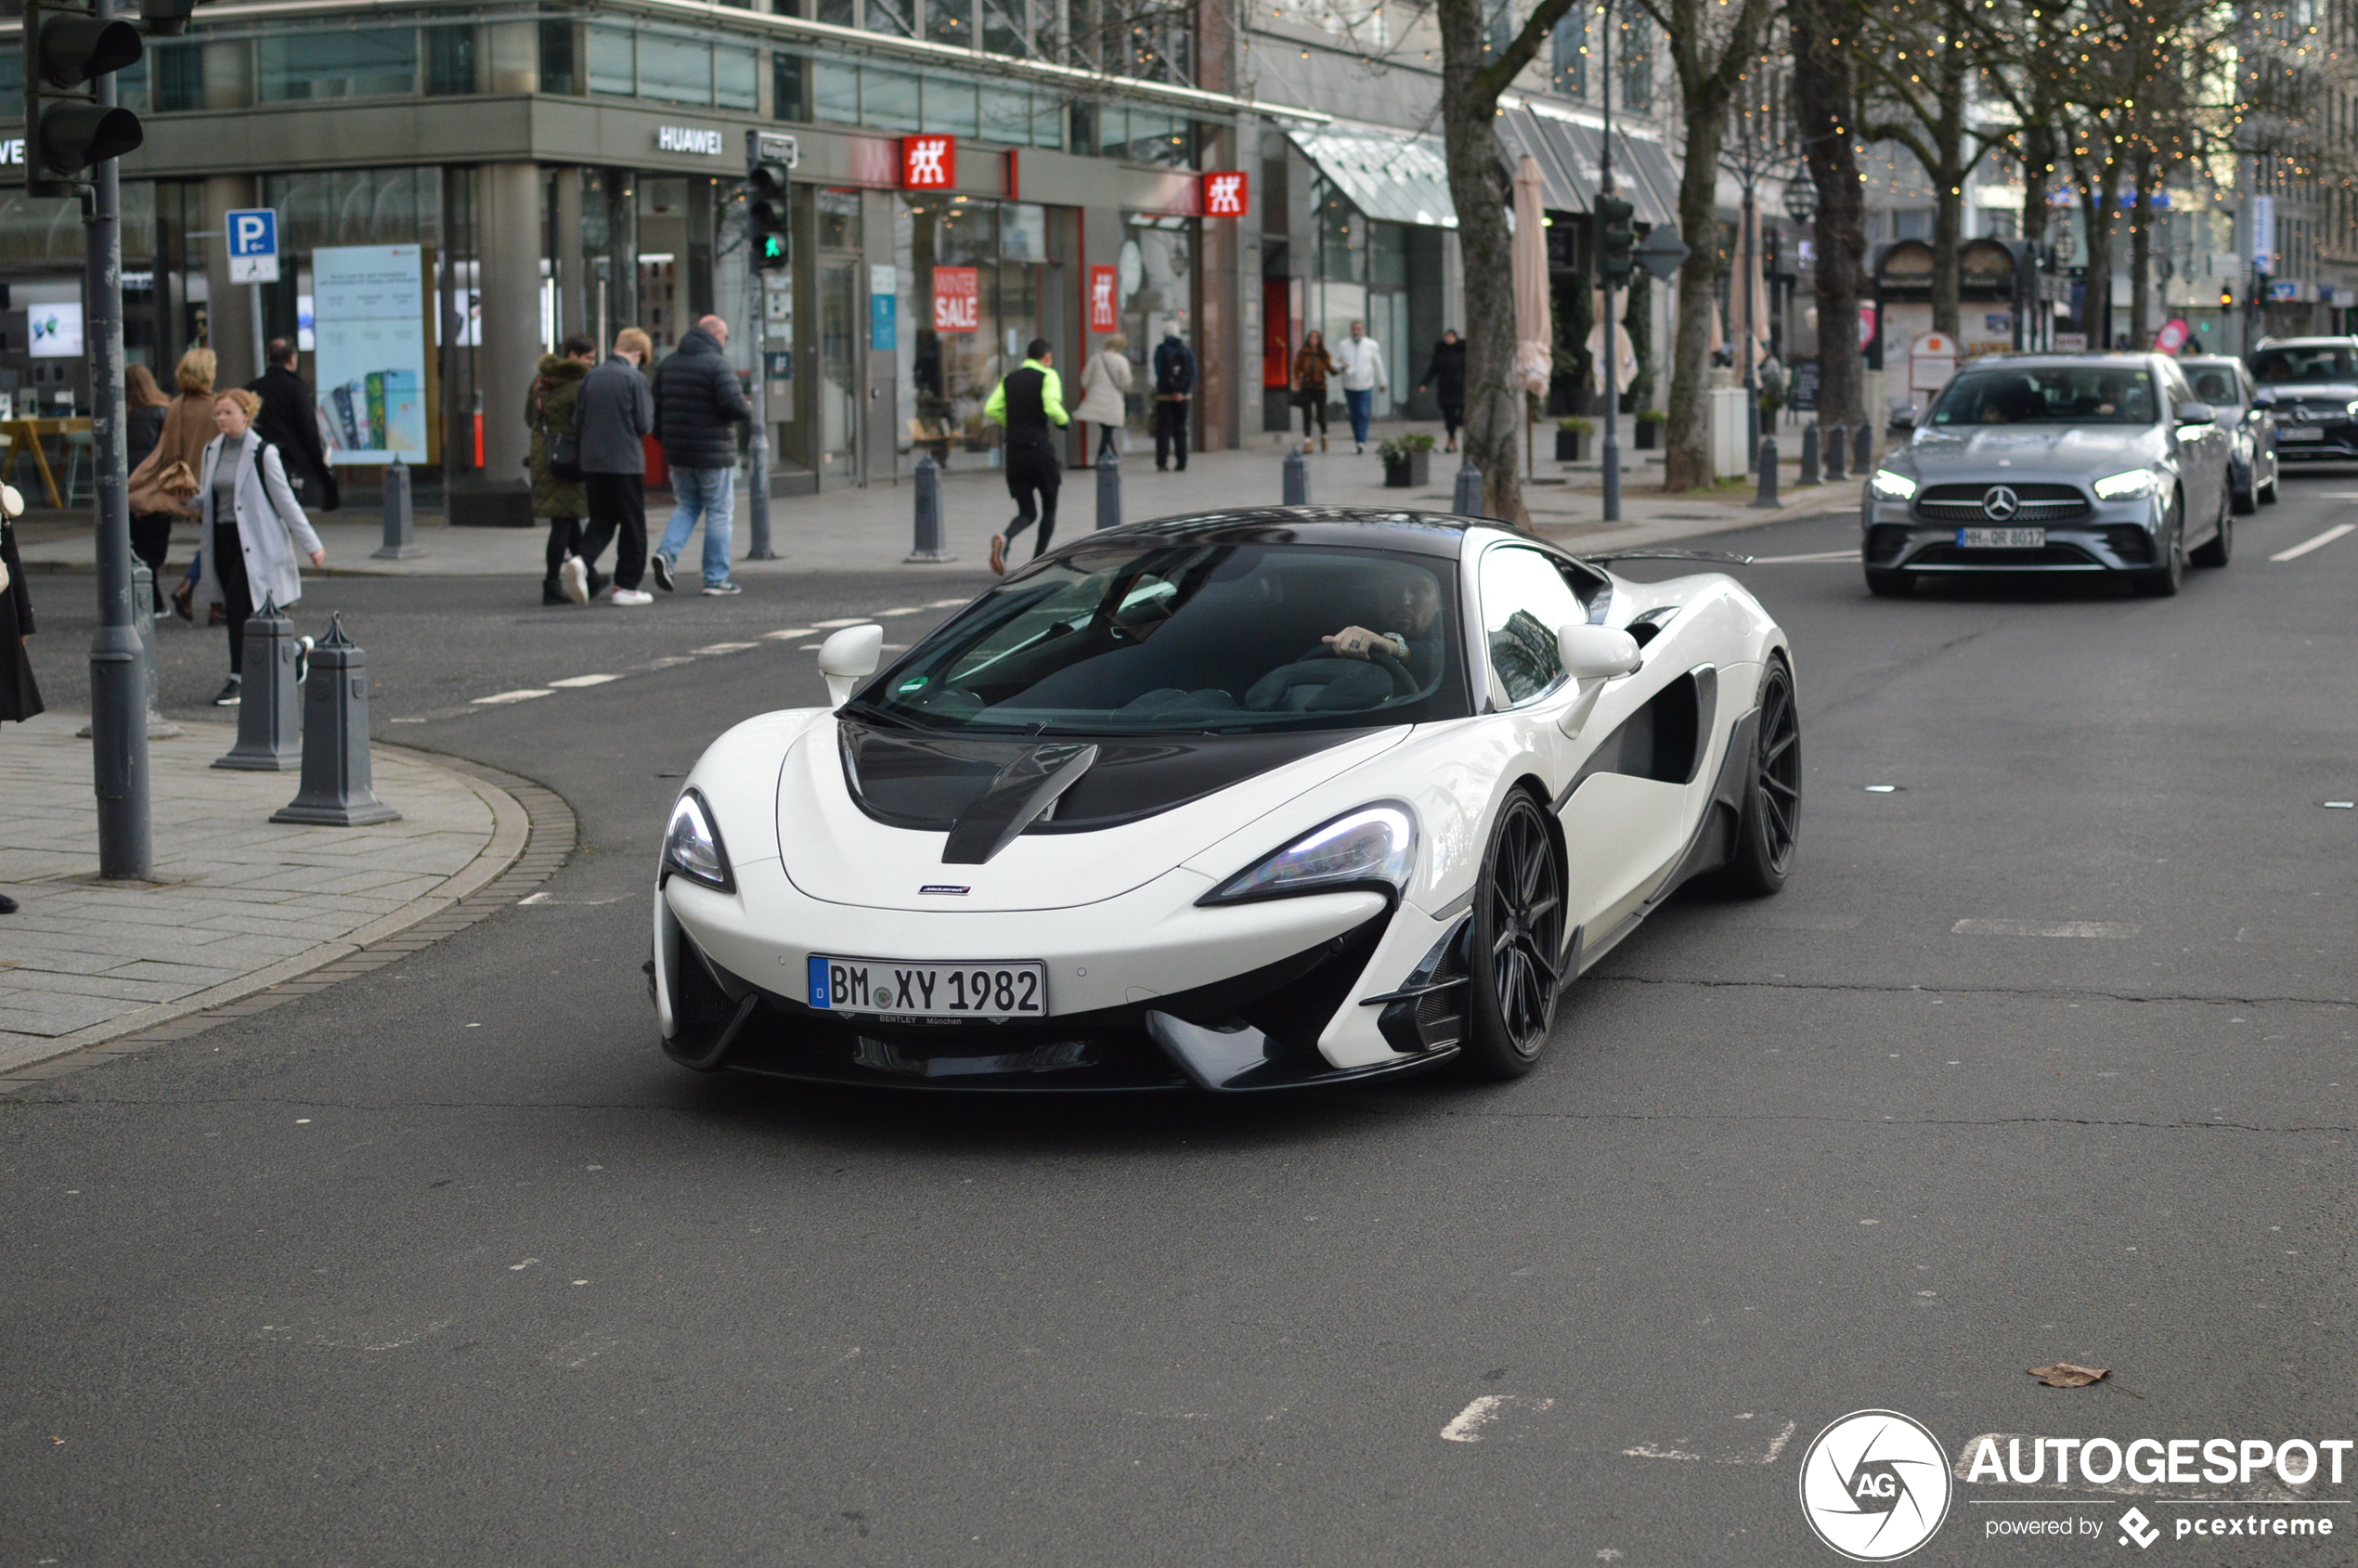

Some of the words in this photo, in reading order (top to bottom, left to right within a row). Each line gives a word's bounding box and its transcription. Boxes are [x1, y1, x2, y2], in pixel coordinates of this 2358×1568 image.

[660, 125, 722, 155] HUAWEI
[238, 215, 266, 253] P
[936, 297, 977, 328] SALE
[816, 987, 824, 999] D
[831, 965, 869, 1006] BM
[894, 969, 937, 1009] XY
[948, 970, 1039, 1011] 1982
[879, 1015, 916, 1024] BENTLEY
[926, 1017, 962, 1025] München
